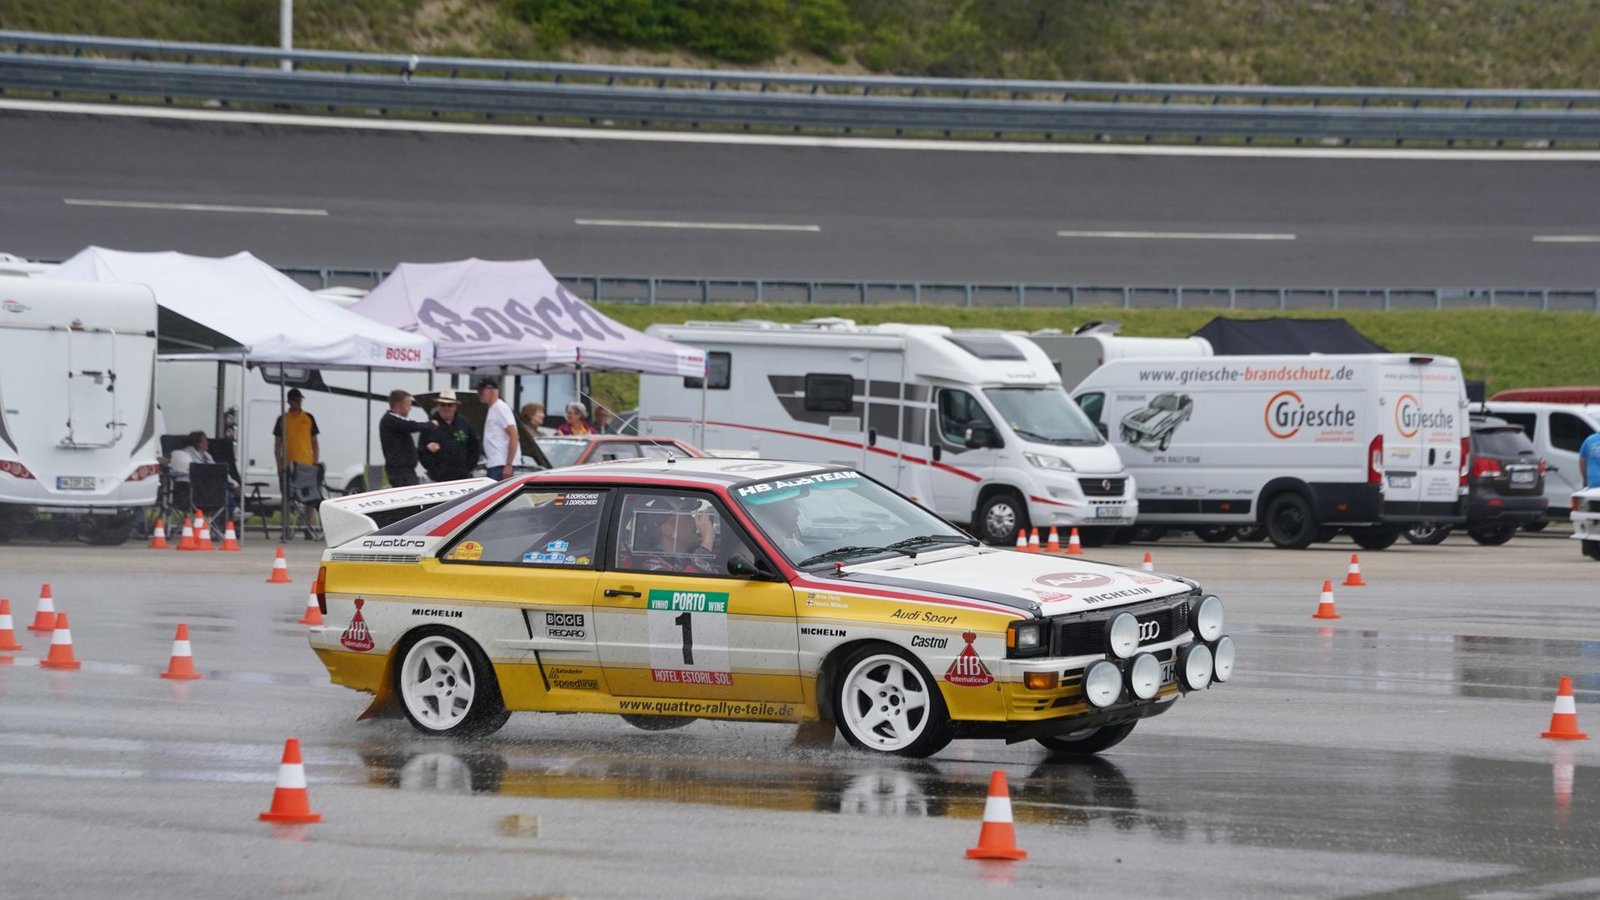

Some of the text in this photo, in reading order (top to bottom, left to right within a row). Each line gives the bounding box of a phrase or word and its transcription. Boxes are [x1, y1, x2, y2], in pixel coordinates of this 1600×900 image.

[386, 347, 421, 362] BOSCH
[1139, 365, 1353, 385] www.griesche-brandschutz.de
[738, 483, 772, 496] HB
[812, 471, 860, 482] TEAM
[363, 538, 425, 548] quattro
[652, 593, 725, 612] VINHO PORTO WINE
[1082, 587, 1152, 604] MICHELIN
[412, 609, 463, 618] MICHELIN
[546, 613, 584, 627] BOGE
[891, 609, 957, 624] Audi Sport
[549, 629, 585, 638] RECARO
[675, 612, 694, 665] 1
[801, 628, 847, 637] MICHELIN
[911, 635, 948, 649] Castrol
[957, 655, 981, 676] HB
[655, 670, 732, 685] HOTEL ESTORIL SOL
[619, 700, 794, 716] www.quattro-rallye-teile.de
